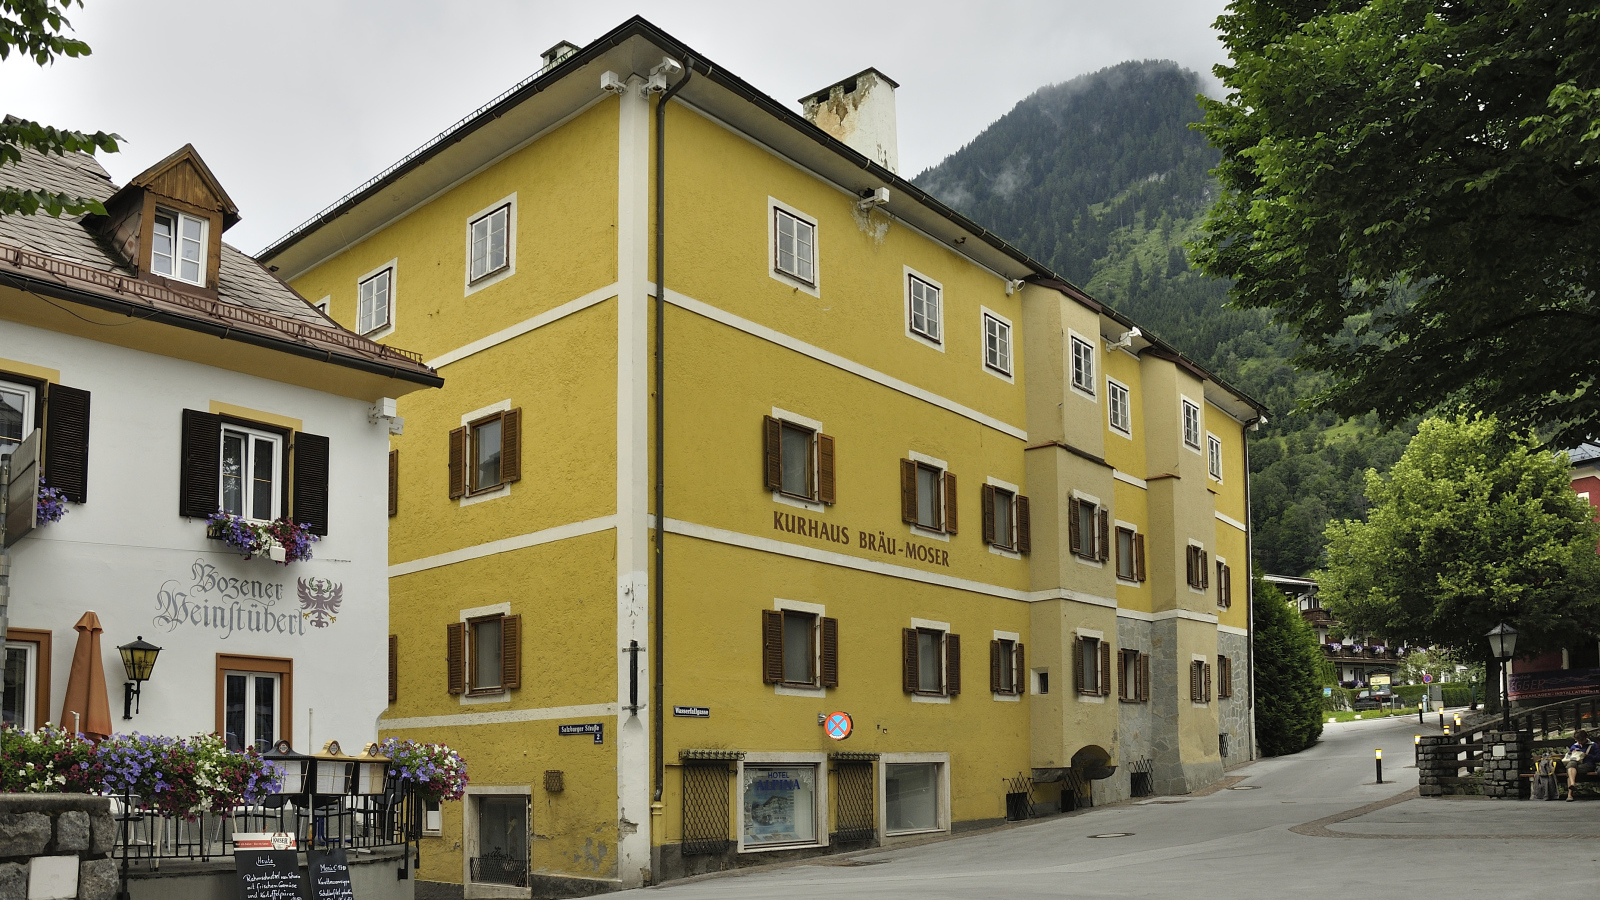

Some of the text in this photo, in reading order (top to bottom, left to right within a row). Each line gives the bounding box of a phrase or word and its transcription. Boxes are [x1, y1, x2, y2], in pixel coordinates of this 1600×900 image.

[773, 510, 950, 567] KURHAUS BRÄU-MOSER
[190, 557, 283, 601] Bozener
[757, 779, 800, 790] ALPINA
[257, 855, 274, 864] Heute
